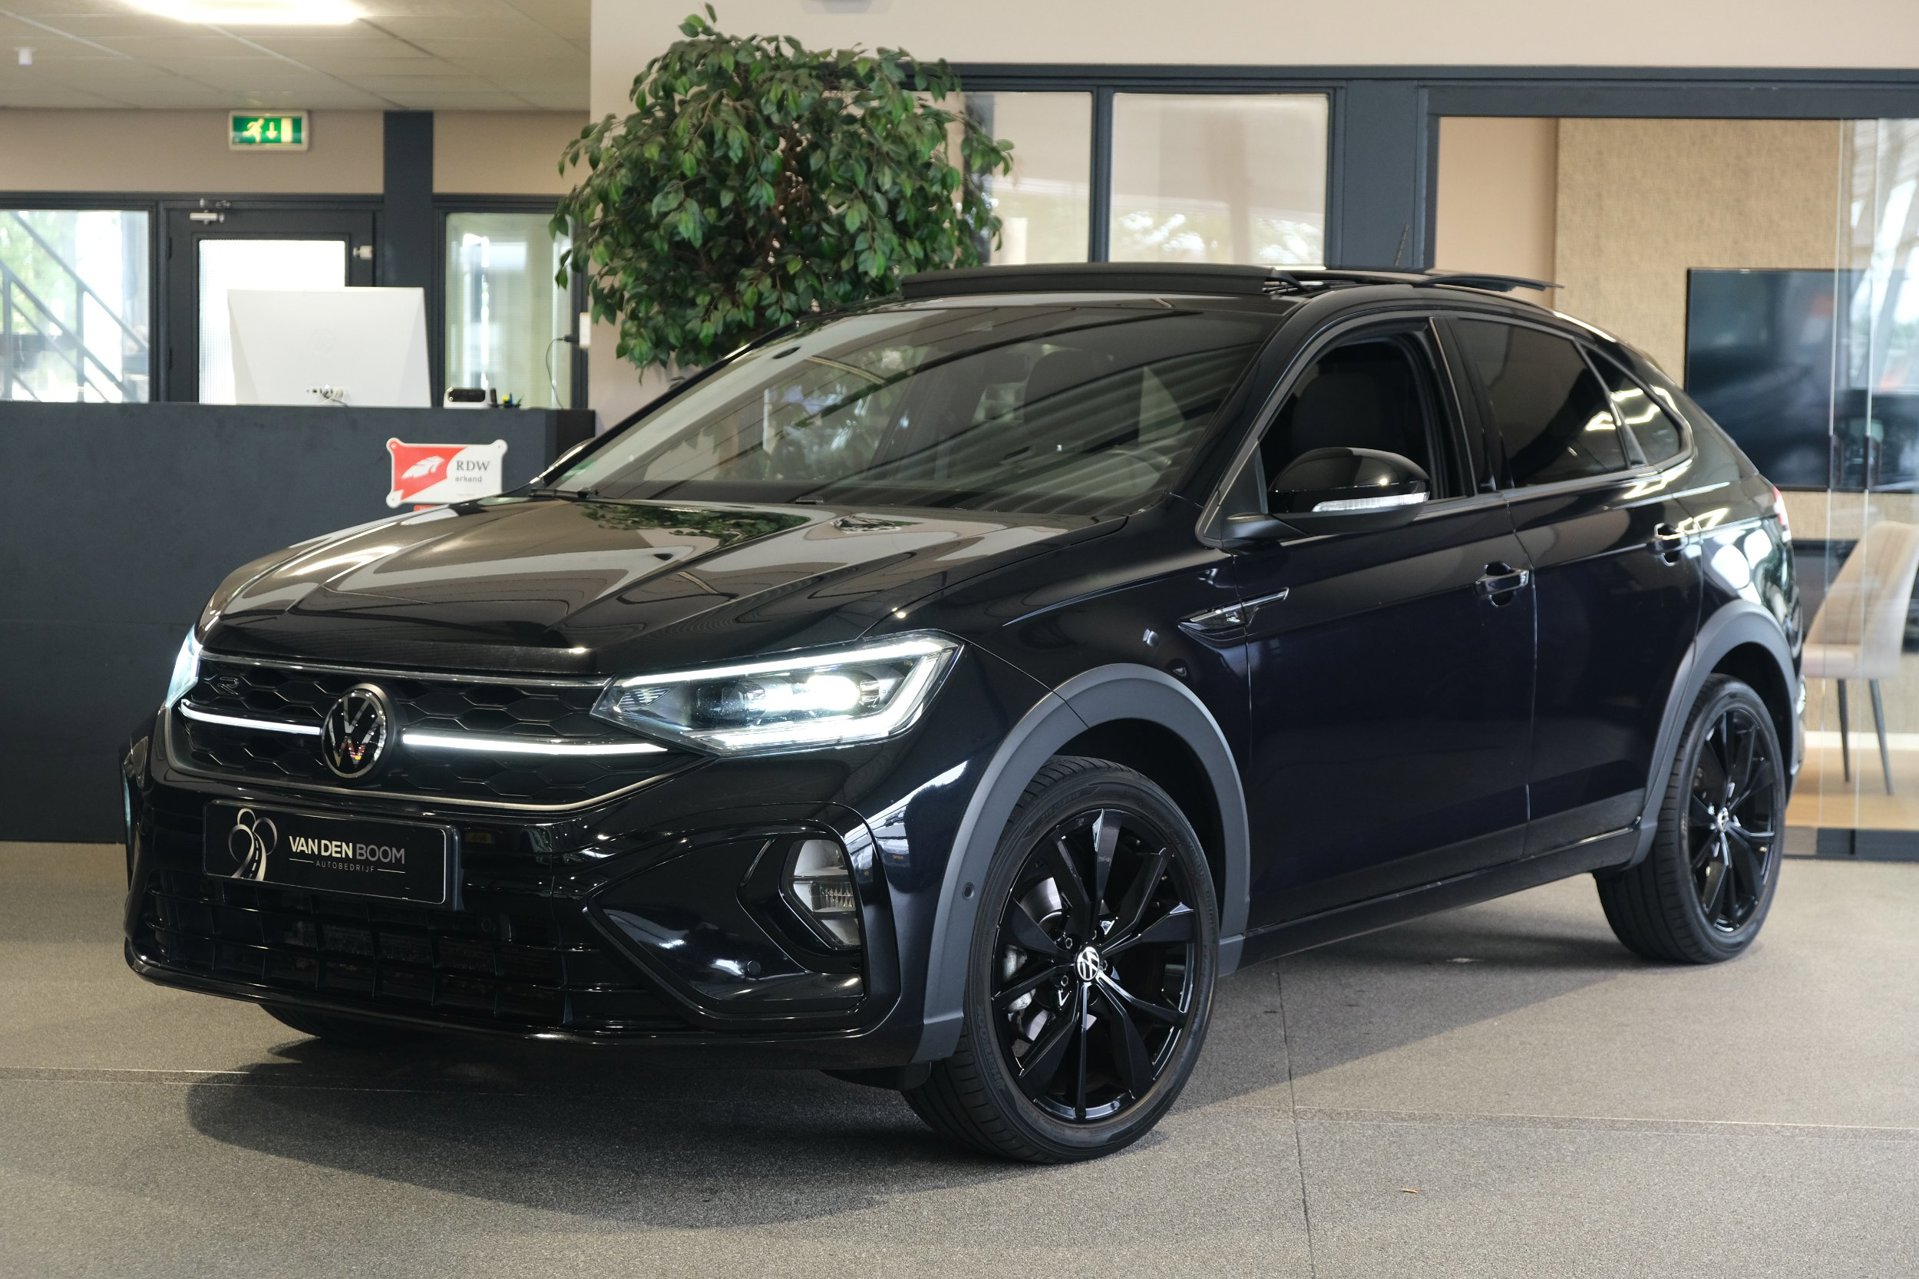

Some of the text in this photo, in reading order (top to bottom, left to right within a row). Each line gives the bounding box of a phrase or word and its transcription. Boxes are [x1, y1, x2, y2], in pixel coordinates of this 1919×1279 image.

[456, 460, 490, 471] RDW
[288, 835, 405, 864] VAN DEN BOOM
[315, 860, 375, 873] AUTOBEDRIJF
